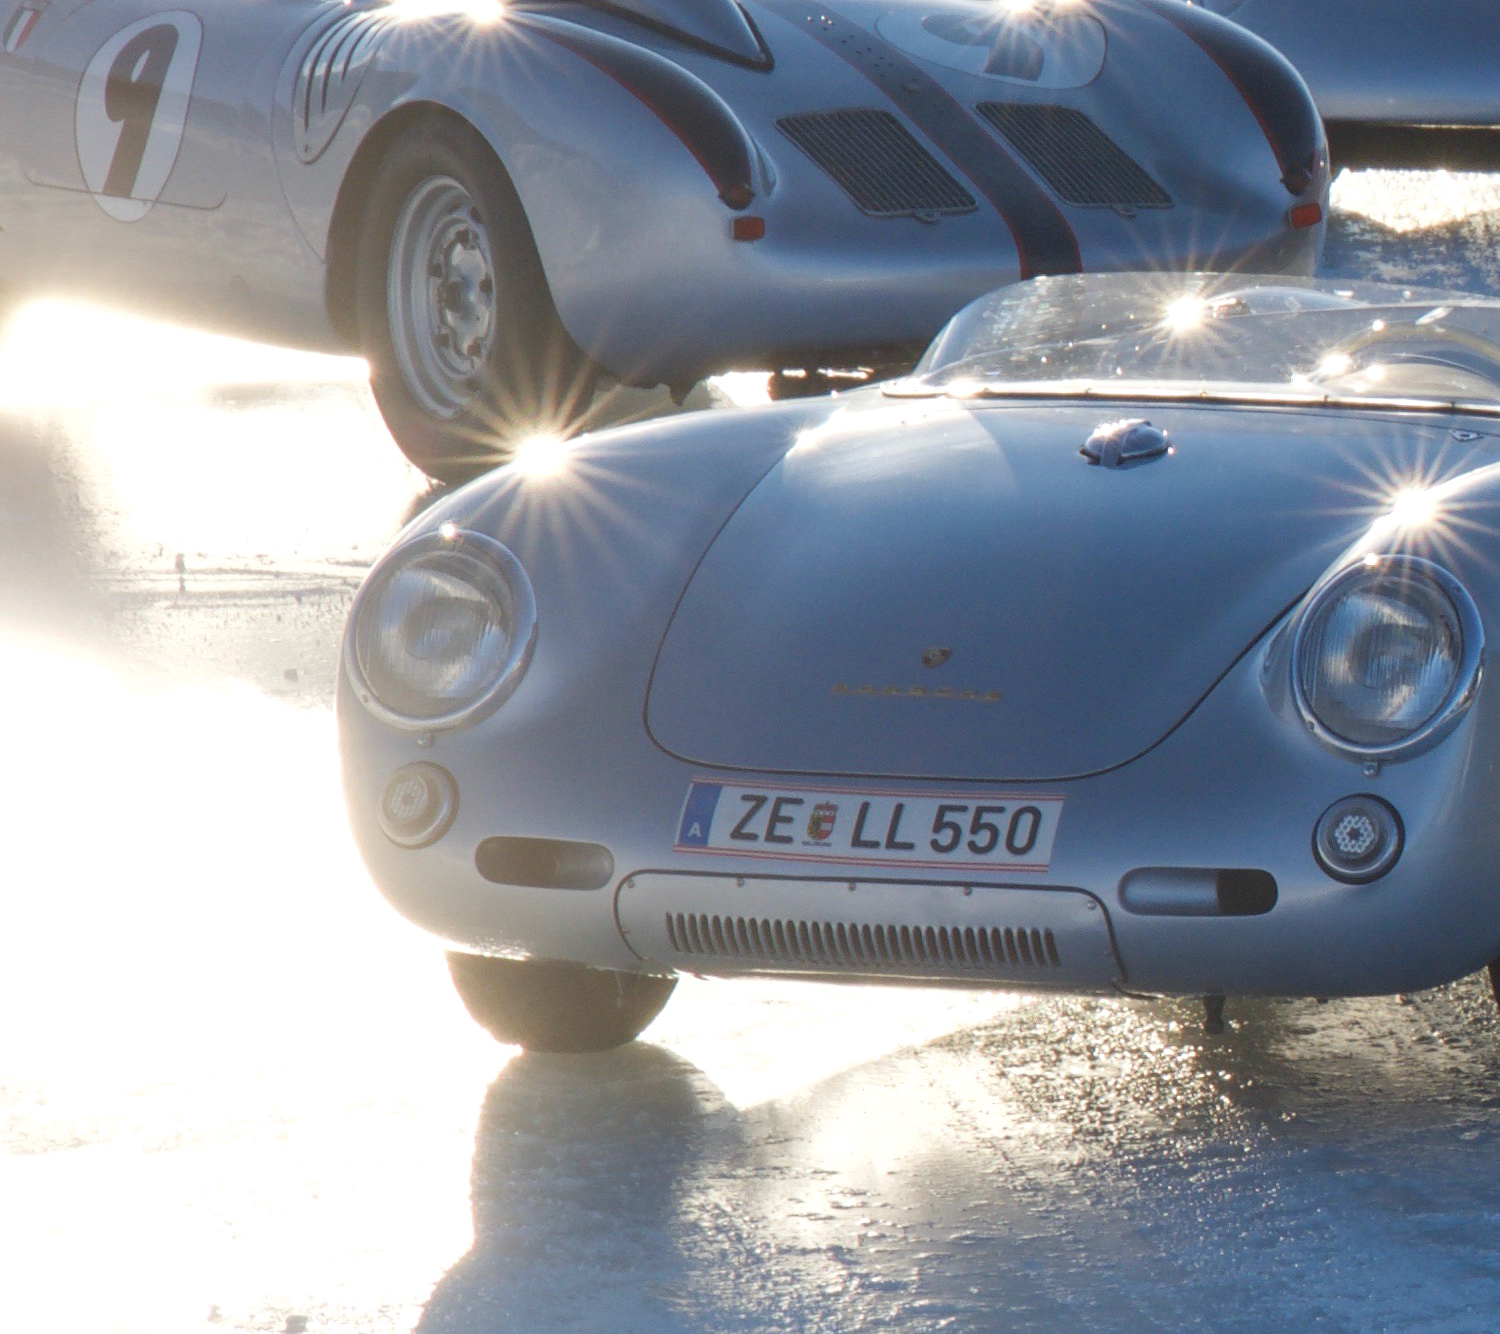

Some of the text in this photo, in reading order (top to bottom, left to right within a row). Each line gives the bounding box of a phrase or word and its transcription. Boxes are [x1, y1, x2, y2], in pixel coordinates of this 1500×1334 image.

[104, 24, 179, 198] 9
[687, 822, 701, 838] A
[730, 794, 1042, 855] ZE LL 550
